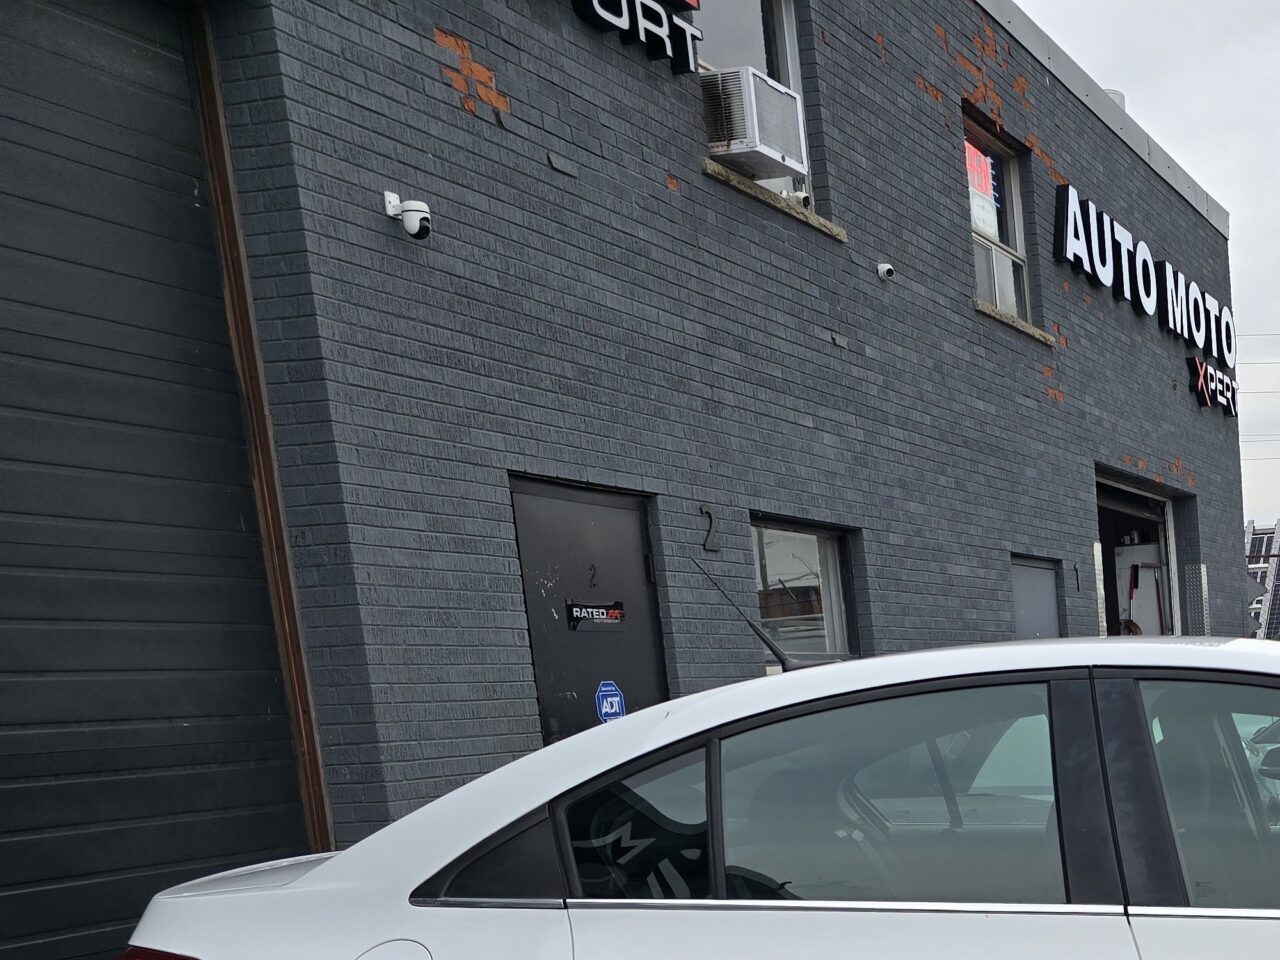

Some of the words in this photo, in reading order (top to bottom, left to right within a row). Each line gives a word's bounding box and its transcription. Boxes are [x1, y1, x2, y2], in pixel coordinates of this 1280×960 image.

[1066, 185, 1157, 316] AUTO
[1165, 261, 1237, 369] MOTO
[699, 503, 720, 553] 2
[589, 563, 599, 589] 2
[573, 608, 607, 619] RATED
[602, 697, 620, 714] ADT
